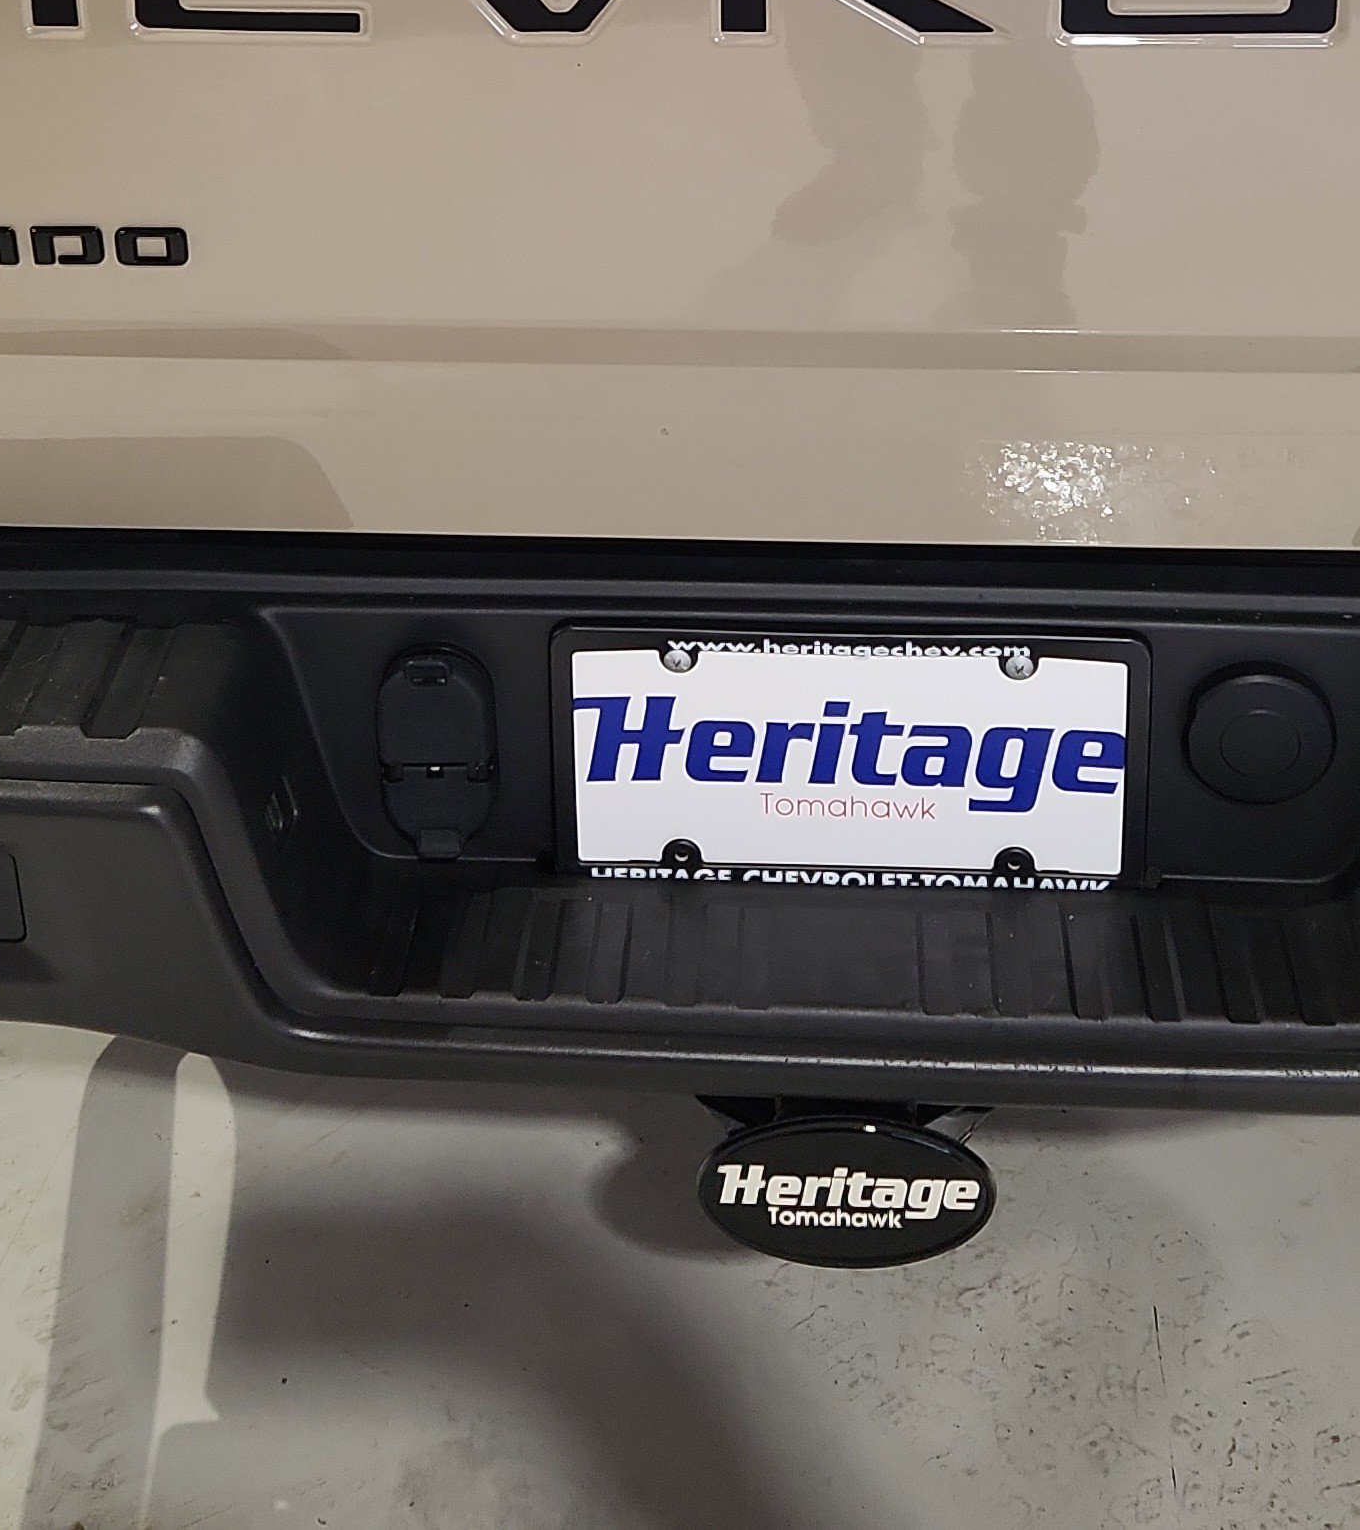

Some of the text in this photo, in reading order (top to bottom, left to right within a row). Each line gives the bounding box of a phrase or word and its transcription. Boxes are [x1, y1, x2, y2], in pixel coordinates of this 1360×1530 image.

[667, 638, 1031, 658] www.heritagechev.com
[573, 696, 1126, 813] Heritage
[759, 792, 936, 821] Tomahawk
[717, 1164, 980, 1220] Heritage
[767, 1206, 904, 1230] Tomahawk
